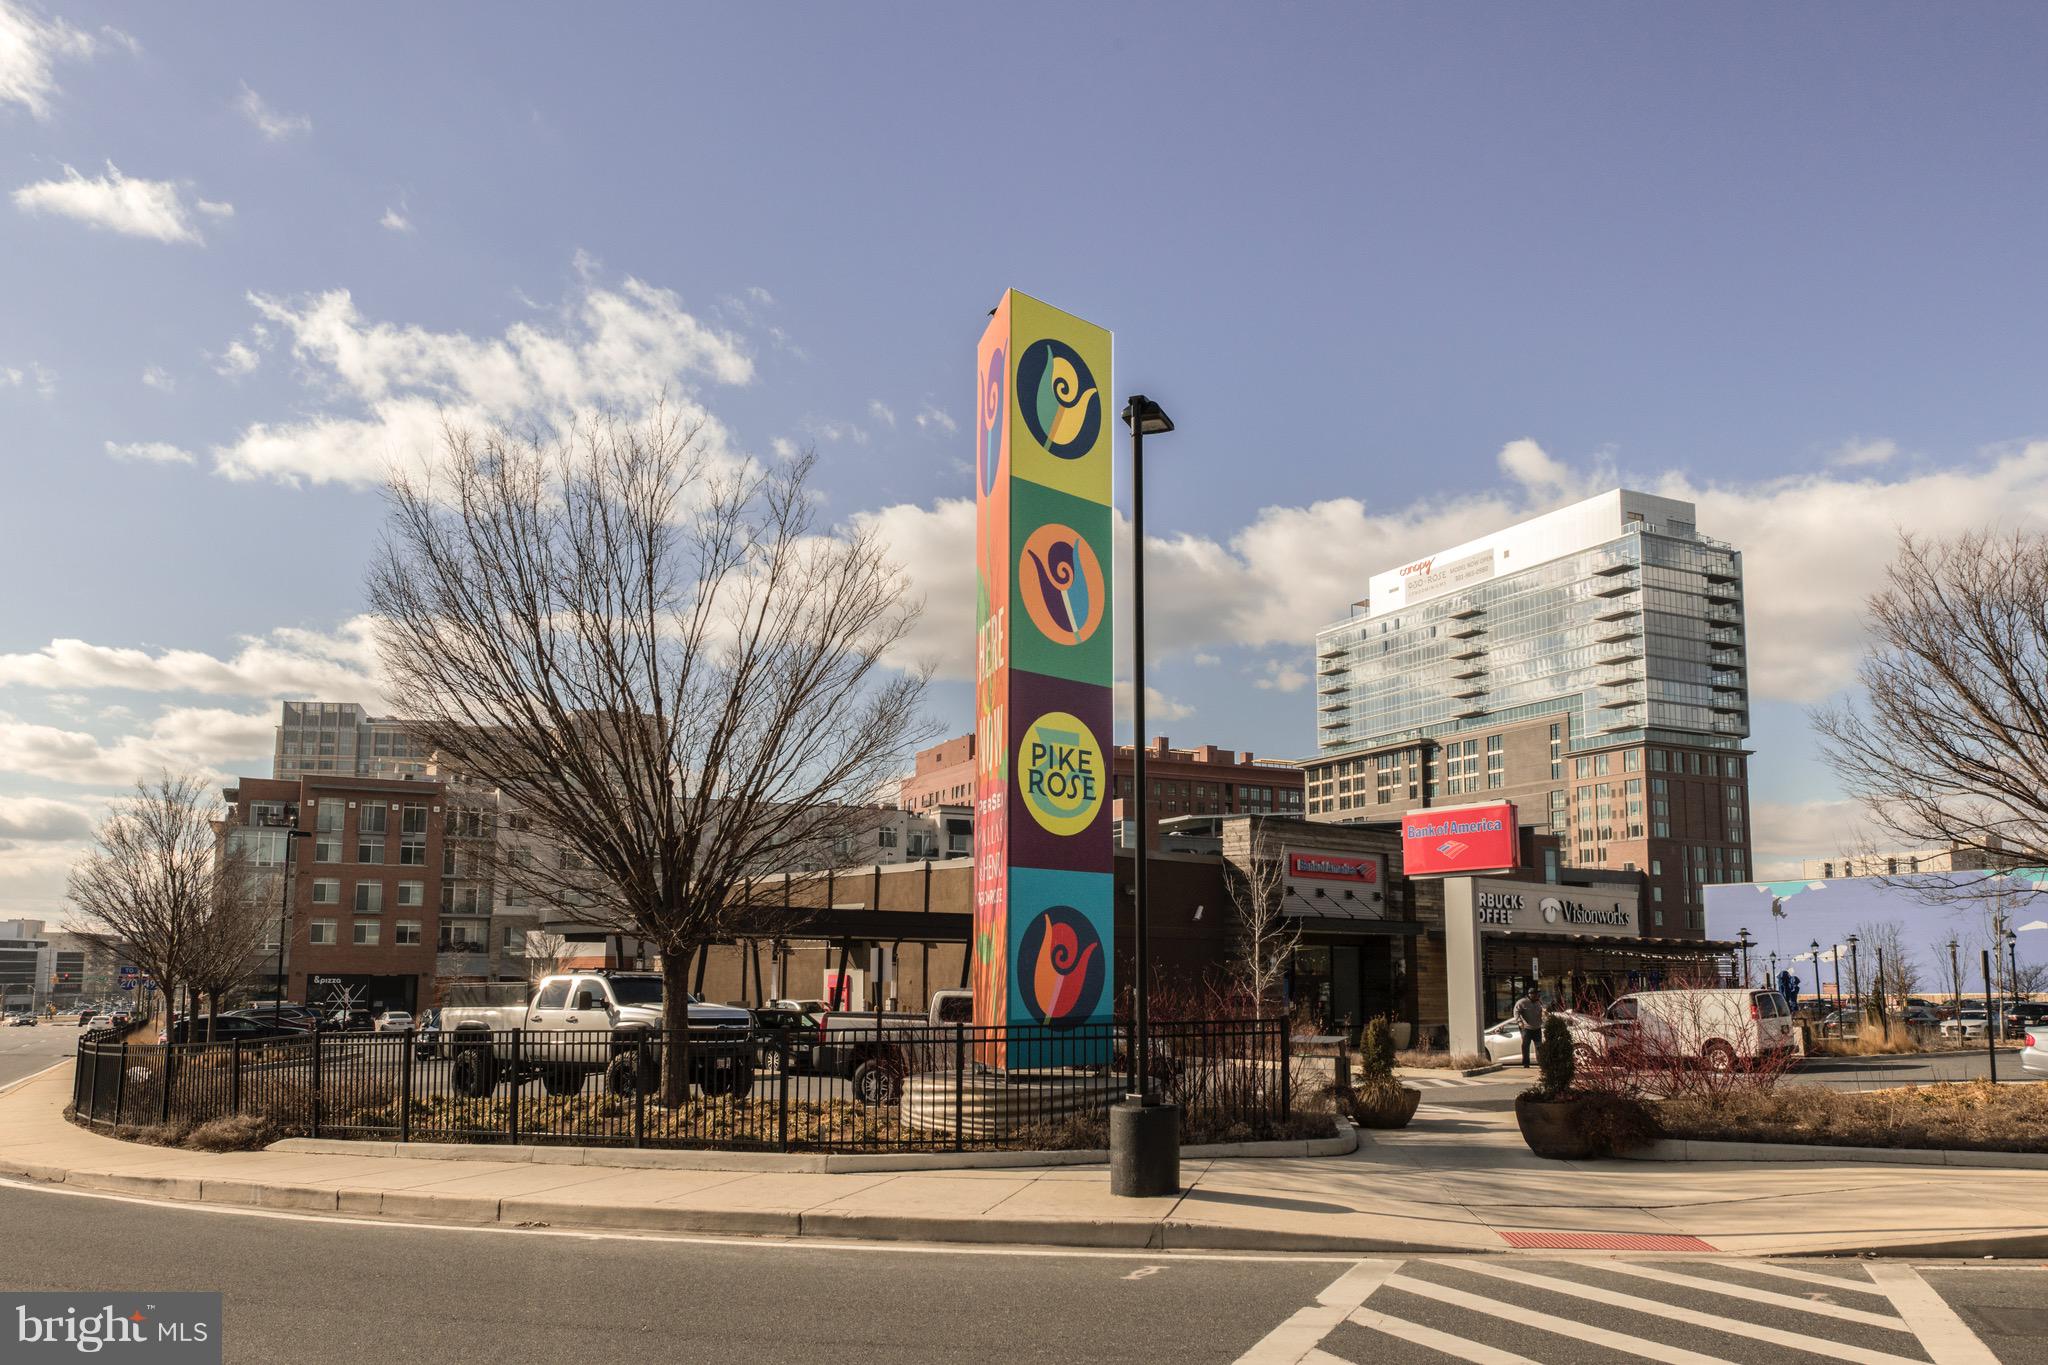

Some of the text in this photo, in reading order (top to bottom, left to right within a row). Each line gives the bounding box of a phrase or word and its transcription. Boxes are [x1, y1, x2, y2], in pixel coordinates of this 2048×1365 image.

[1399, 557, 1436, 576] canopy
[1428, 571, 1447, 583] ROSE
[978, 606, 1005, 685] HERE
[978, 704, 1003, 777] NOW
[1032, 742, 1092, 774] PIKE
[1028, 768, 1096, 801] ROSE
[1407, 818, 1502, 839] Bank of America
[1562, 900, 1631, 925] Visionworks
[120, 979, 138, 988] 270
[314, 975, 342, 984] &pizza
